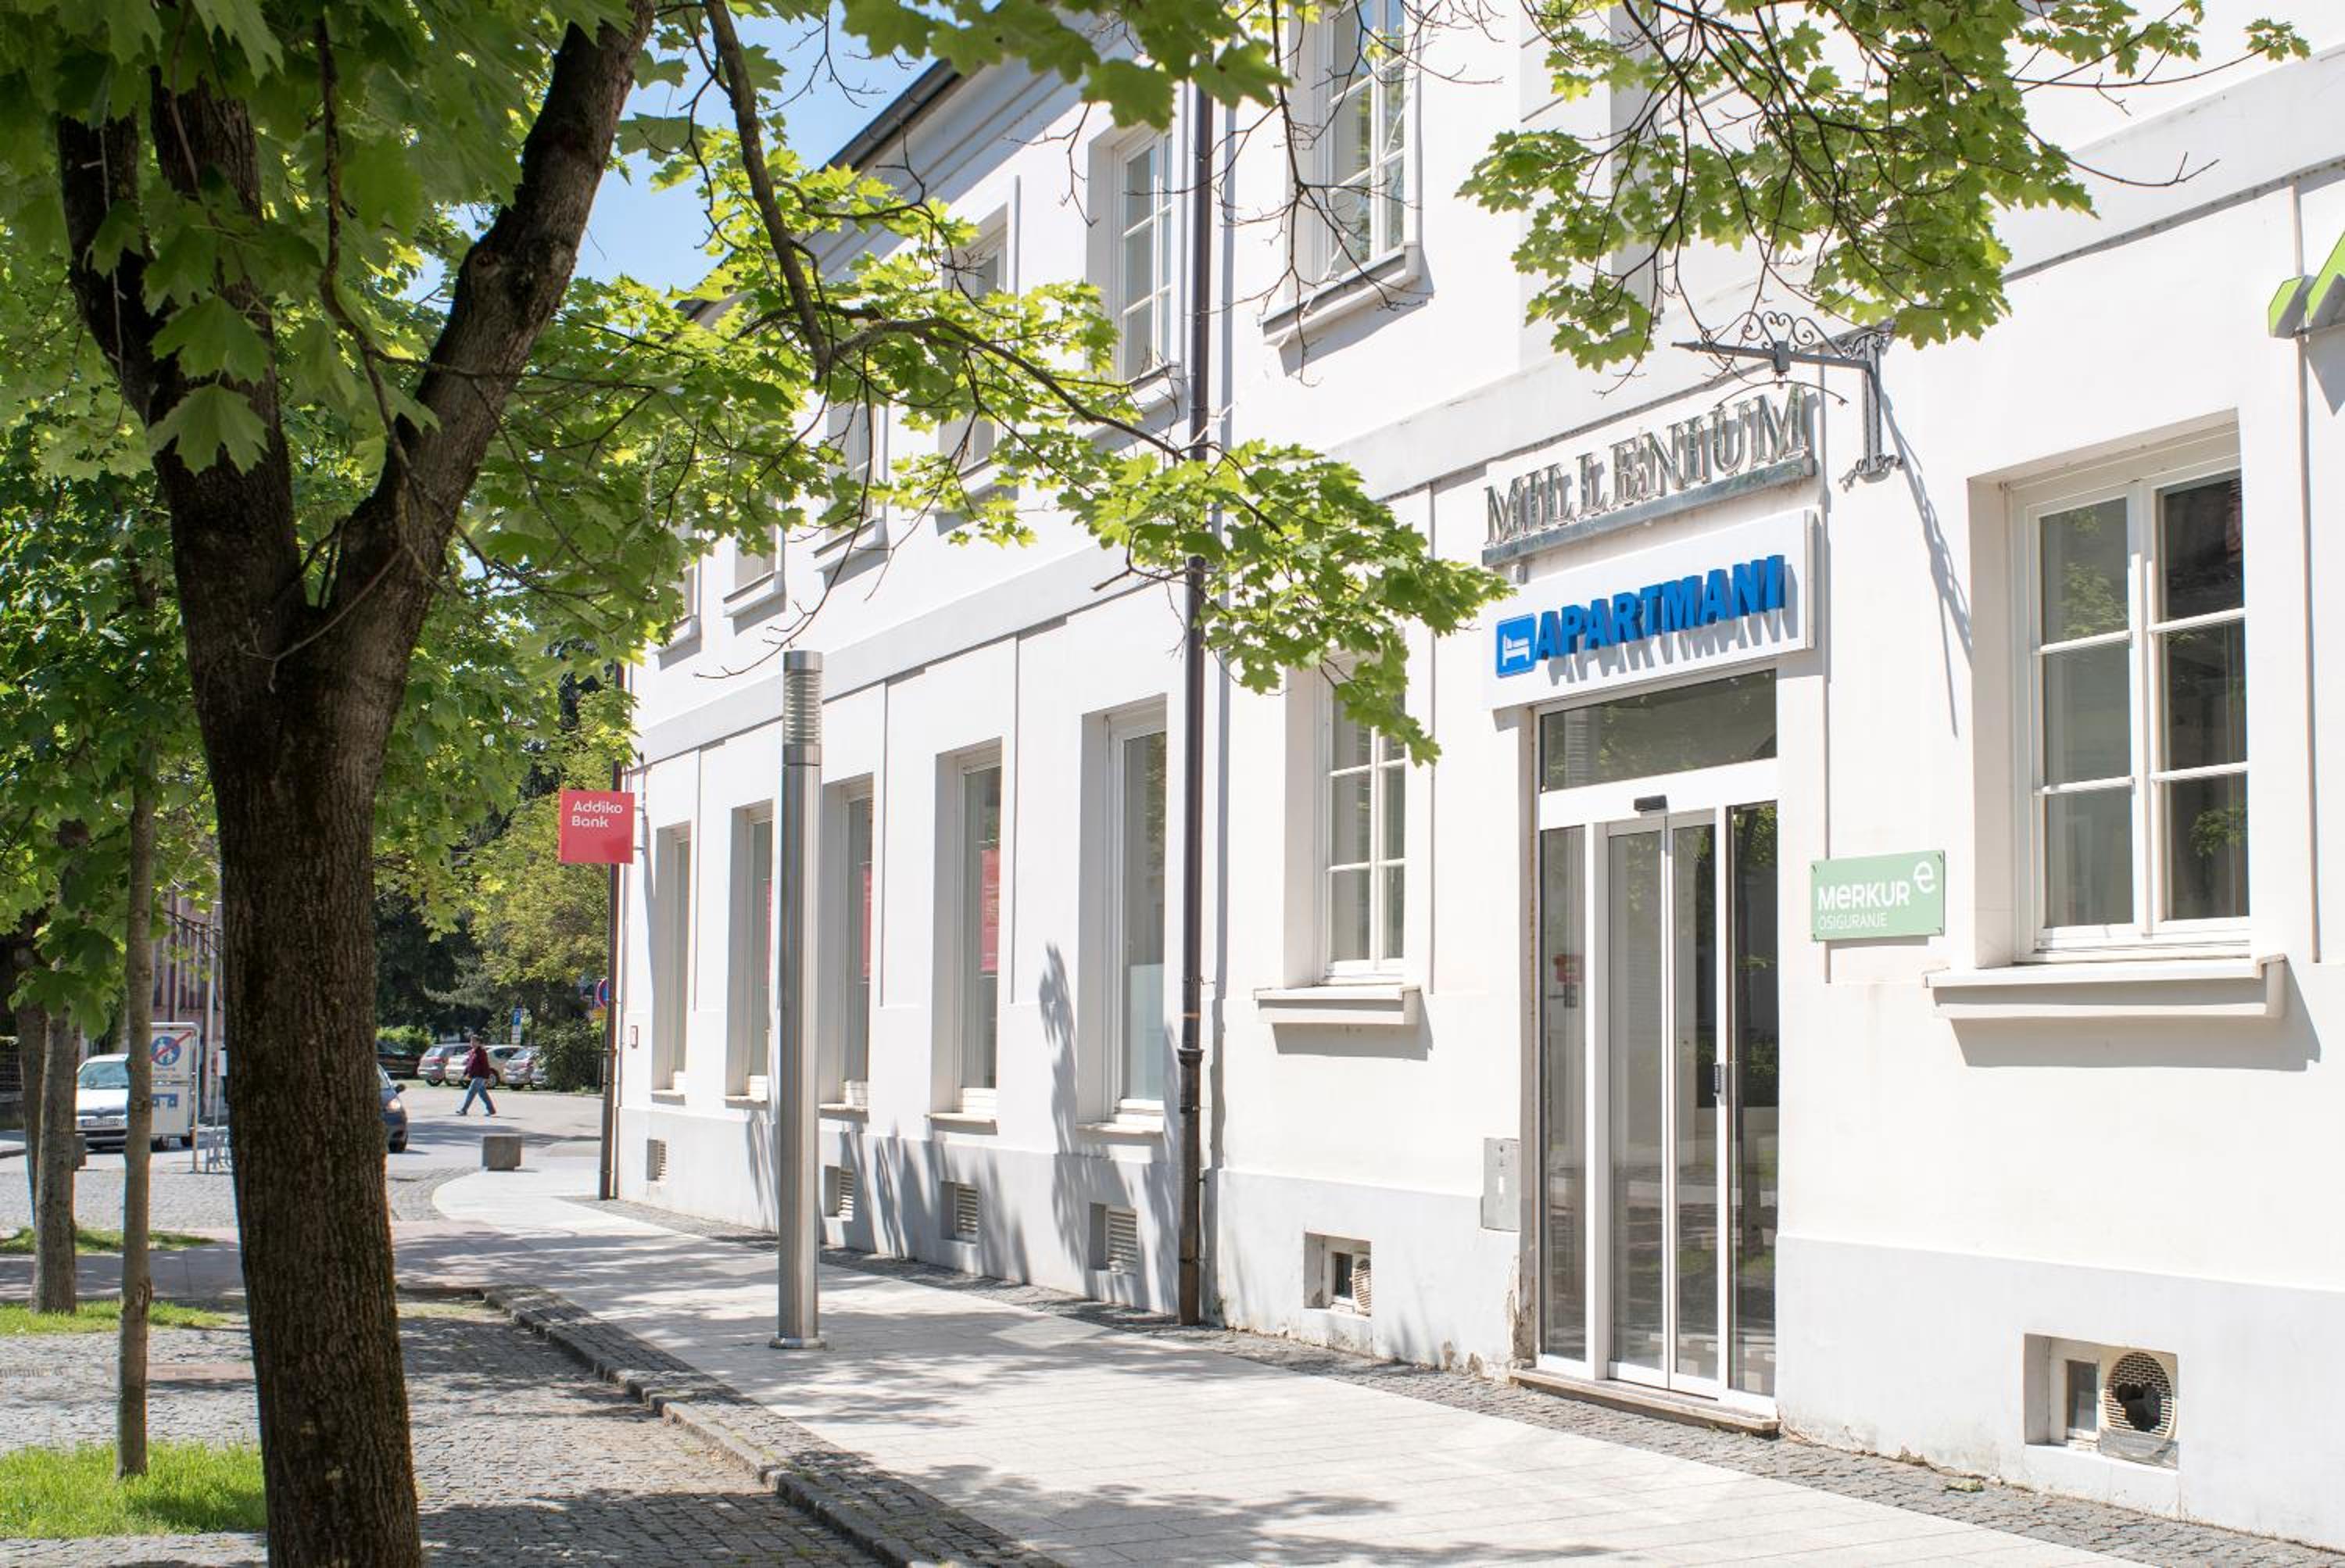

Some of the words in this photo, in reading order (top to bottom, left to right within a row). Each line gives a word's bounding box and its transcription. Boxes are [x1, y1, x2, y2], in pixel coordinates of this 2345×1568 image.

[1484, 384, 1811, 546] MILLENIUM
[1534, 554, 1786, 660] APARTMANI
[573, 800, 623, 814] Addiko
[571, 815, 609, 828] Bank
[1817, 912, 1888, 931] OSIGURANJE
